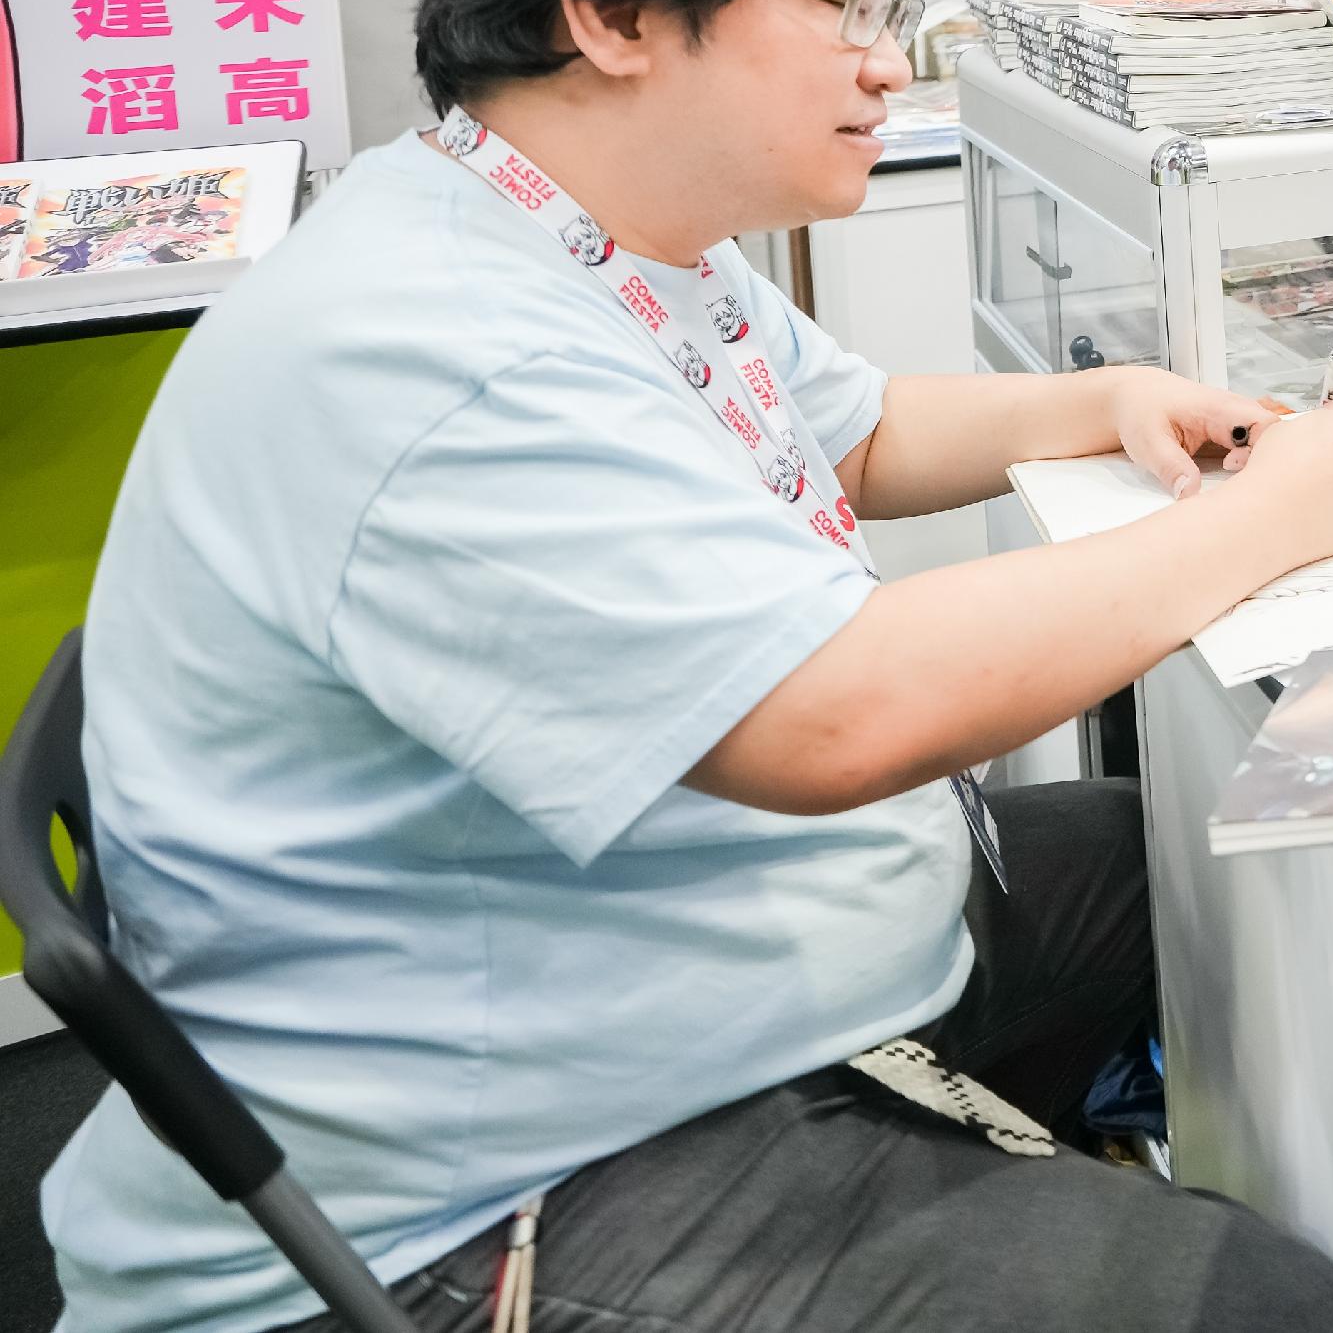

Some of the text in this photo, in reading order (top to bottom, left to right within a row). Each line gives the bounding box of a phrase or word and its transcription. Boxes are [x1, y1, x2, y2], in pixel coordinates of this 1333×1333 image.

[489, 165, 542, 211] COMIC
[505, 153, 557, 202] FIESTA
[619, 283, 661, 333] FIESTA
[628, 275, 669, 323] COMIC
[740, 362, 773, 411] FIESTA
[721, 404, 757, 451] COMIC
